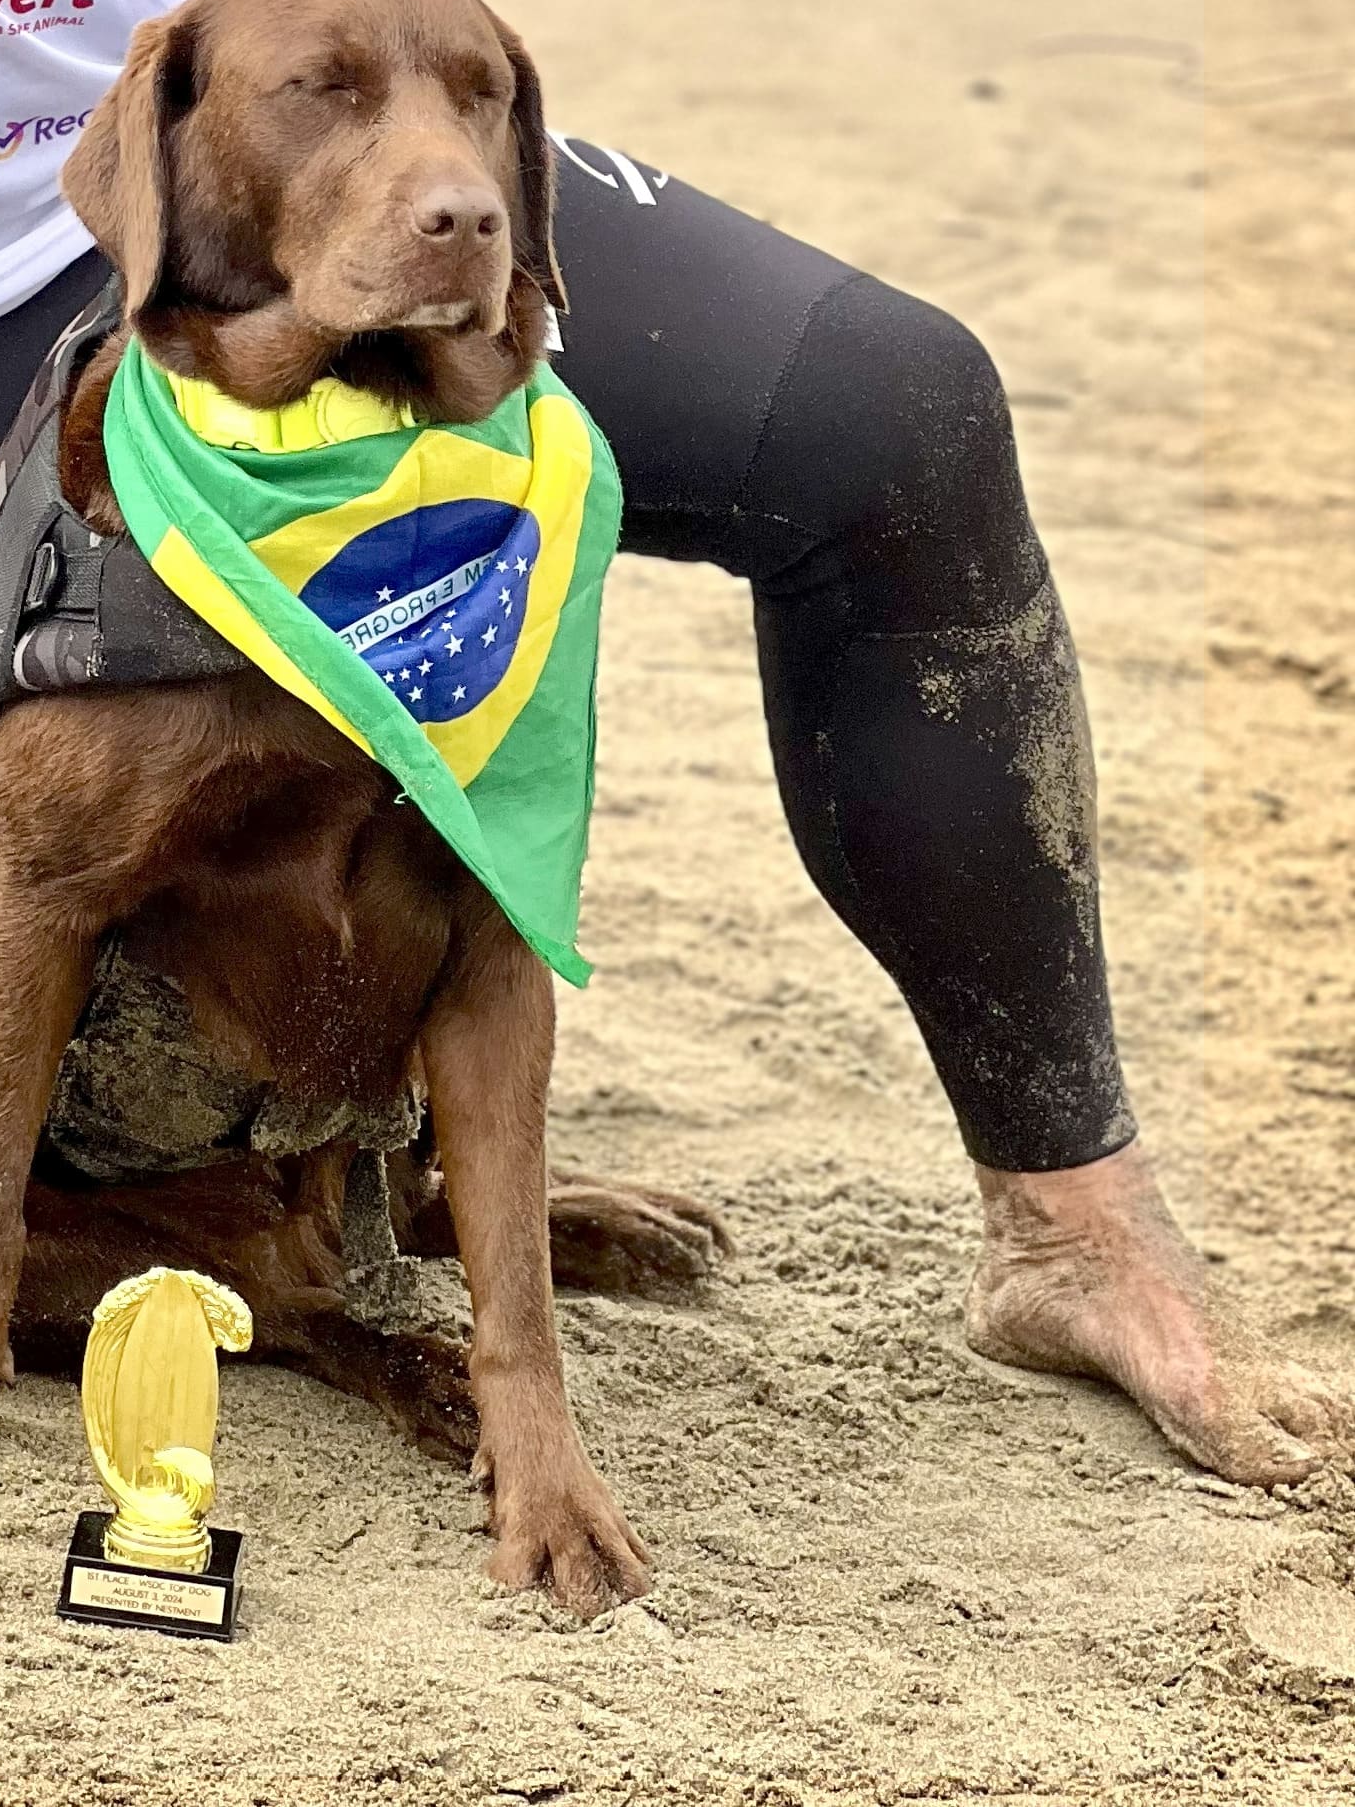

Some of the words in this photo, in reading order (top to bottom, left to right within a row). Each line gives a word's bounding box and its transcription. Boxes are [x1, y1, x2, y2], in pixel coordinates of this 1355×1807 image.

[33, 16, 85, 33] ANIMAL
[102, 1574, 129, 1586] PLACE
[139, 1579, 165, 1591] WSDC
[169, 1583, 187, 1593] TOP
[188, 1586, 212, 1597] DOG
[112, 1587, 149, 1600] AUGUST
[162, 1593, 183, 1604] 2024
[90, 1594, 140, 1609] PRESENTED
[141, 1602, 152, 1610] BY
[155, 1603, 202, 1618] NESTMENT
